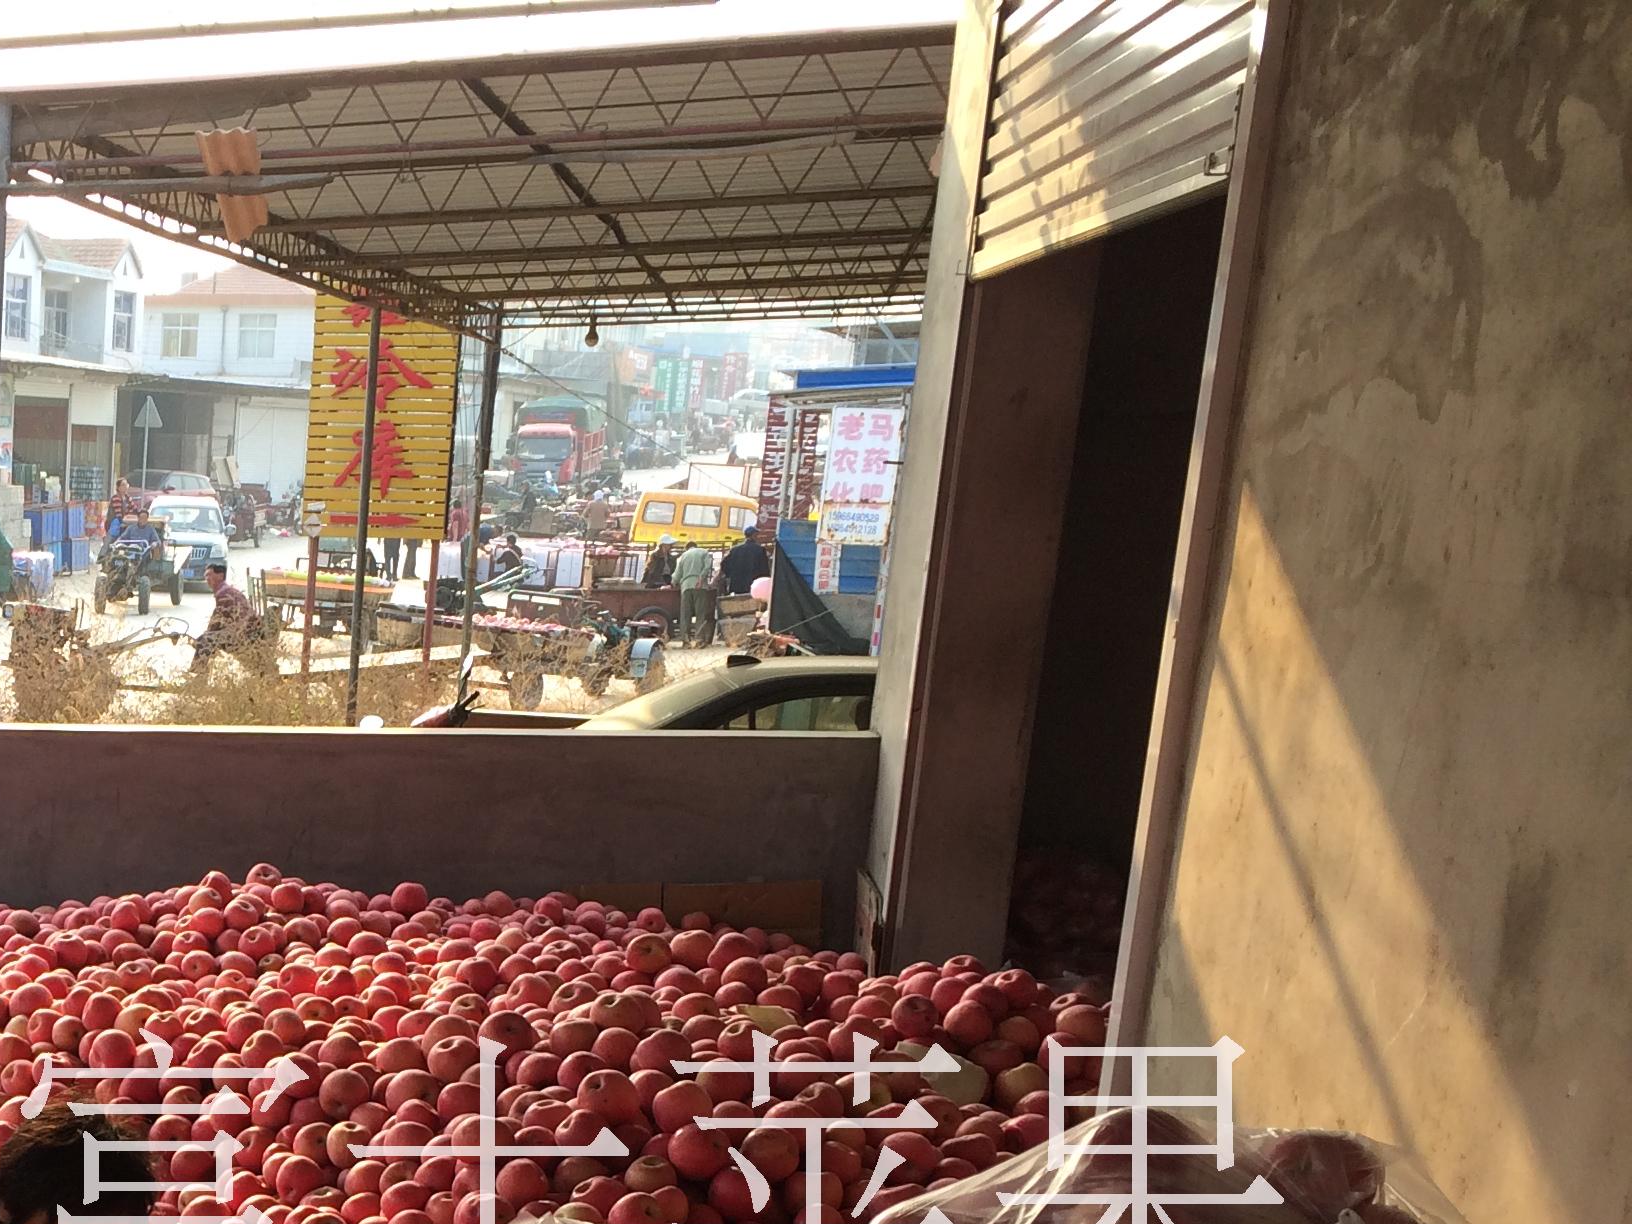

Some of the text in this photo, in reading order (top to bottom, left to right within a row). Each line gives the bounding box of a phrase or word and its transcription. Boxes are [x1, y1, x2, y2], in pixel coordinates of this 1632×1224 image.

[836, 413, 894, 441] 老马
[832, 447, 890, 475] 农药
[829, 480, 885, 510] 化肥
